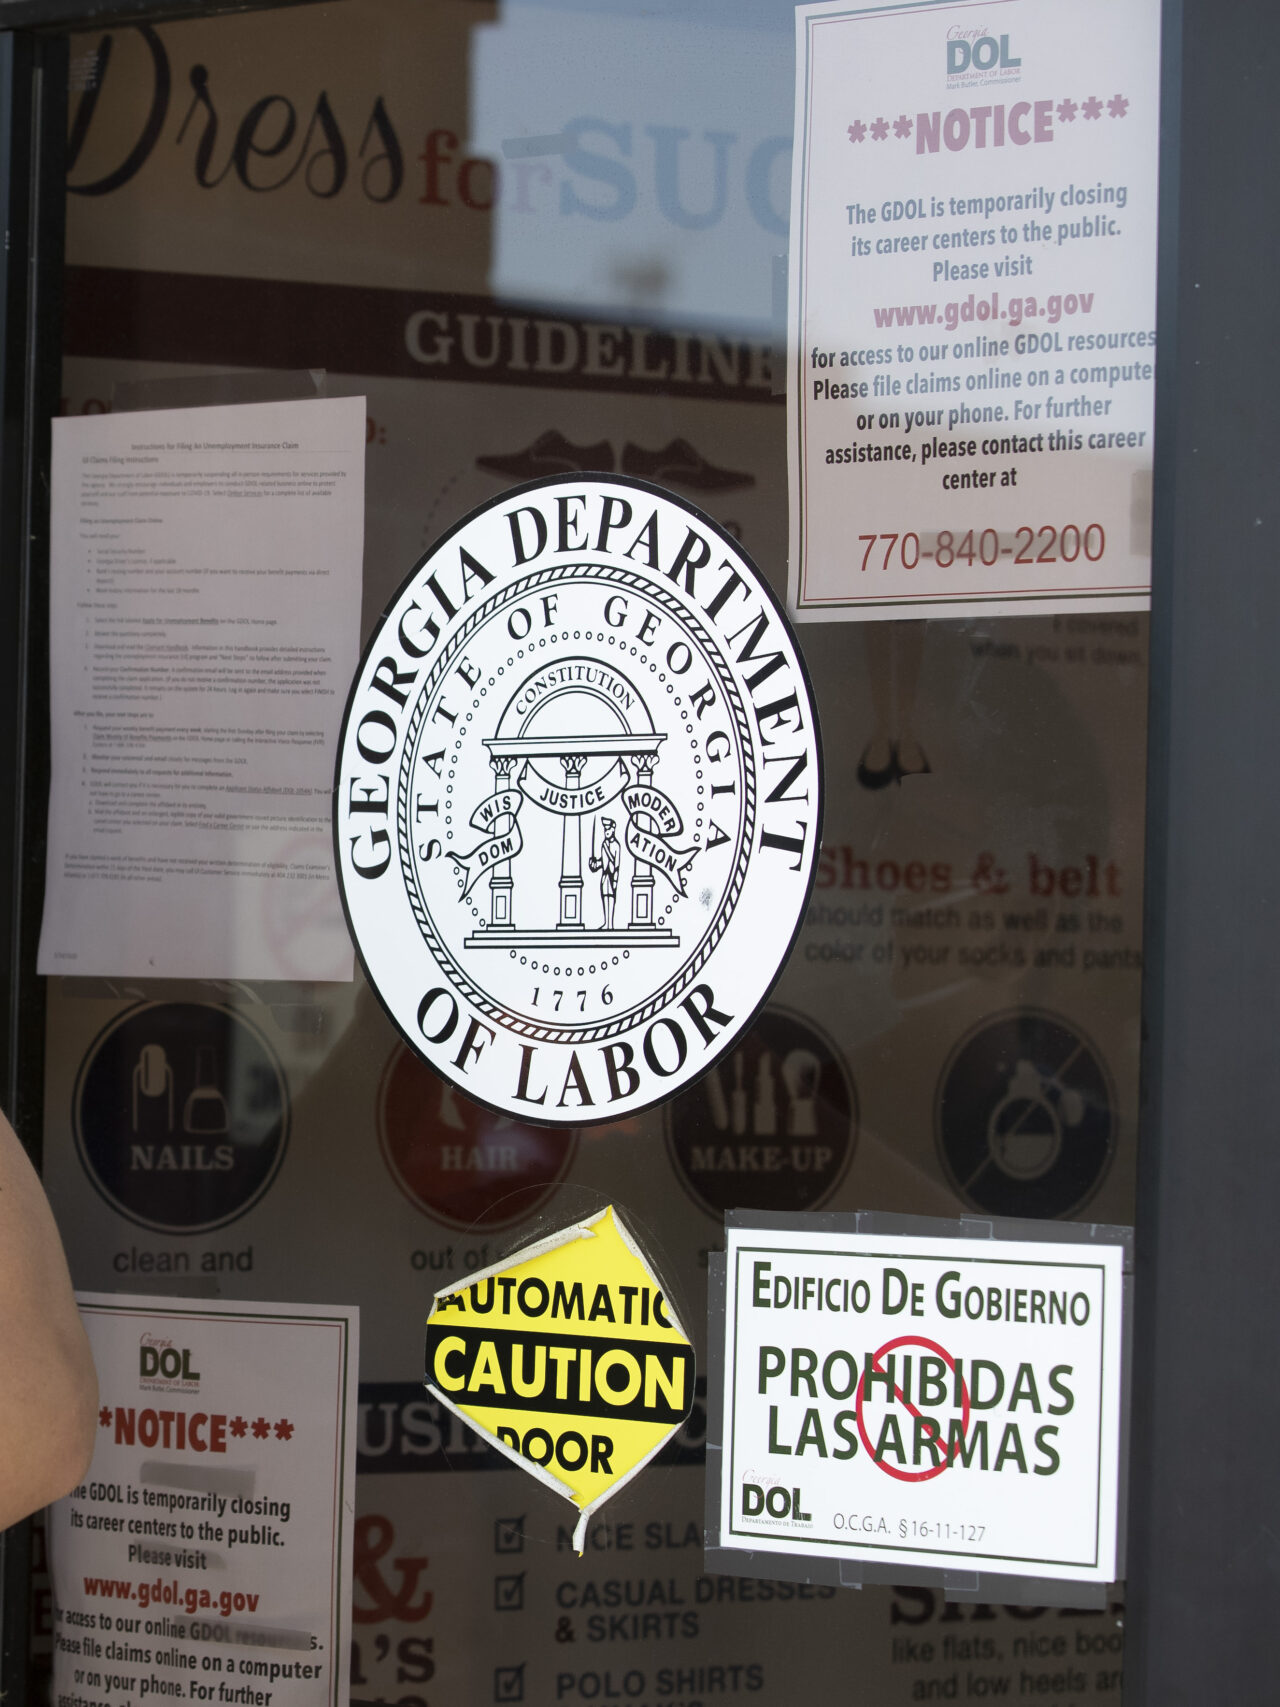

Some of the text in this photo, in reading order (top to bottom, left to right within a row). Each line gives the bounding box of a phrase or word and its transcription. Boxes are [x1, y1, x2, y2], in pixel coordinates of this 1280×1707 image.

[947, 34, 1022, 75] DOL
[67, 24, 405, 202] Dress
[418, 128, 552, 213] for
[845, 184, 1127, 225] The GDOL is temporarily closing
[851, 214, 1121, 257] its career centers to the public.
[933, 253, 1033, 282] Please visit
[874, 293, 1094, 331] www.gdol.ga.gov
[810, 347, 836, 369] for
[839, 348, 893, 367] access
[896, 344, 914, 364] to
[918, 344, 949, 362] our
[952, 335, 1009, 360] online
[1014, 331, 1063, 355] GDOL
[813, 361, 1155, 401] Please file claims online on a compute
[856, 394, 1112, 434] or on your phone. For further
[825, 429, 1146, 466] assistance, please contact this career
[942, 467, 1017, 490] center at
[858, 523, 1105, 572] 770-840-2200
[349, 494, 812, 880] GEORGIA DEPARTMENT
[515, 665, 636, 717] CONSTITUTION
[416, 593, 736, 862] STATE OF GEORGIA
[539, 784, 606, 809] JUSTICE
[477, 795, 513, 867] WIS DOM
[628, 793, 677, 872] MODER ATION
[815, 846, 1122, 898] Shoes & belt
[968, 911, 995, 931] as
[1003, 908, 1050, 932] well
[1054, 912, 1081, 933] as
[1089, 908, 1124, 933] the
[804, 941, 864, 963] color
[872, 941, 893, 962] of
[902, 945, 950, 970] your
[957, 945, 1026, 966] socks
[1033, 946, 1077, 967] and
[530, 983, 614, 1012] 1776
[416, 983, 735, 1107] OF LABOR
[131, 1145, 234, 1171] NAILS
[441, 1146, 518, 1171] HAIR
[691, 1145, 832, 1173] MAKE-UP
[113, 1246, 253, 1274] clean and
[411, 1245, 489, 1270] out of
[752, 1261, 1090, 1326] EDIFICIO DE GOBIERNO
[140, 1346, 200, 1381] DOL
[433, 1336, 685, 1411] CAUTION
[758, 1345, 1075, 1416] PROHIBIDAS
[496, 1426, 613, 1475] DOOR
[768, 1405, 858, 1460] LAS
[874, 1414, 1061, 1476] ARMAS
[89, 1482, 291, 1523] GDOL is temporarily closing
[742, 1483, 812, 1521] DOL
[70, 1507, 285, 1548] its career centers to the public.
[833, 1513, 891, 1535] O.C.G.A.
[128, 1545, 208, 1570] Please visit
[353, 1514, 434, 1625] &
[83, 1577, 260, 1616] www.gdol.ga.gov
[555, 1578, 836, 1609] CASUAL DRESSES
[65, 1610, 96, 1629] access
[98, 1613, 112, 1631] to
[115, 1617, 142, 1634] our
[144, 1618, 187, 1640] online
[555, 1612, 700, 1644] & SKIRTS
[82, 1636, 102, 1659] file
[105, 1640, 152, 1664] claims
[155, 1647, 197, 1670] online
[201, 1656, 222, 1672] on
[226, 1658, 235, 1673] a
[238, 1659, 323, 1682] computer
[891, 1632, 1068, 1665] like flats, nice
[74, 1669, 277, 1707] or on your phone. For further
[556, 1664, 763, 1700] POLO SHIRTS
[911, 1665, 1087, 1702] and low heels
